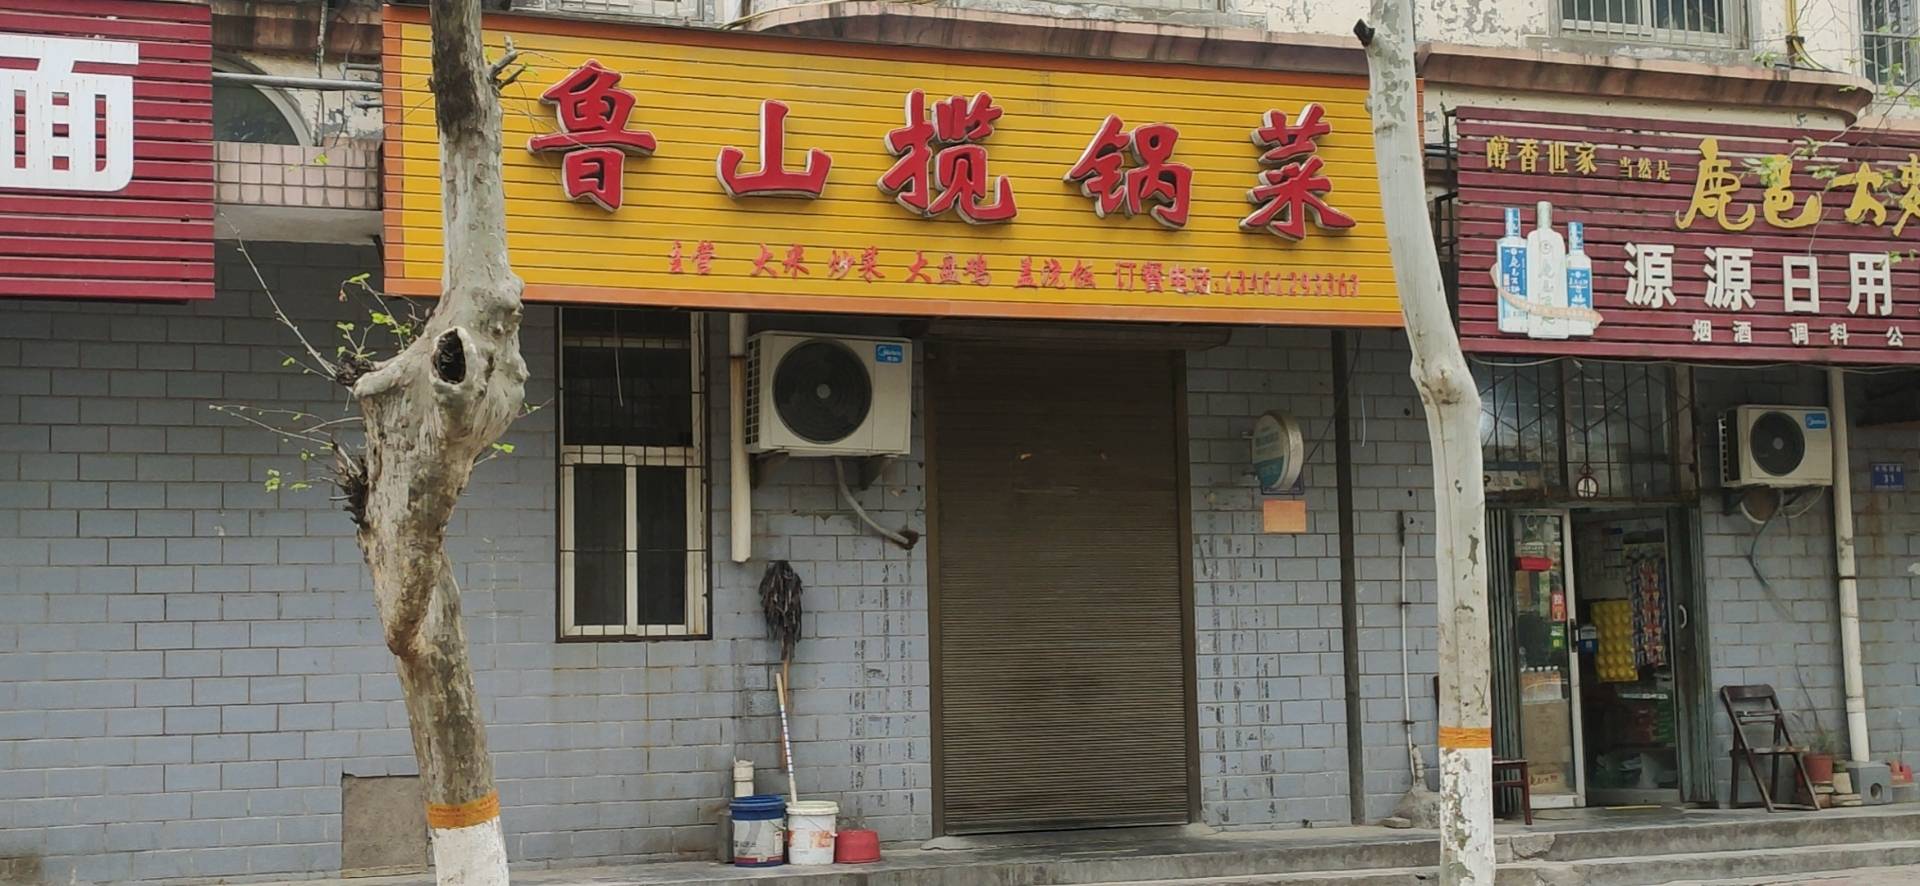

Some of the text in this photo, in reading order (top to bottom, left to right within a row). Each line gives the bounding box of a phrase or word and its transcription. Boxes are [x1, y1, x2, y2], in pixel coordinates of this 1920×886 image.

[0, 32, 139, 192] 面
[527, 59, 1359, 242] 鲁山揽锅菜
[1486, 135, 1598, 176] 醇香世家
[1619, 156, 1672, 181] 当然是
[669, 239, 715, 276] 主营
[827, 245, 886, 283] 炒菜
[905, 249, 992, 287] 大盘鸡
[1623, 242, 1894, 316] 源源日用
[1691, 318, 1753, 344] 烟酒
[1789, 322, 1850, 346] 调料
